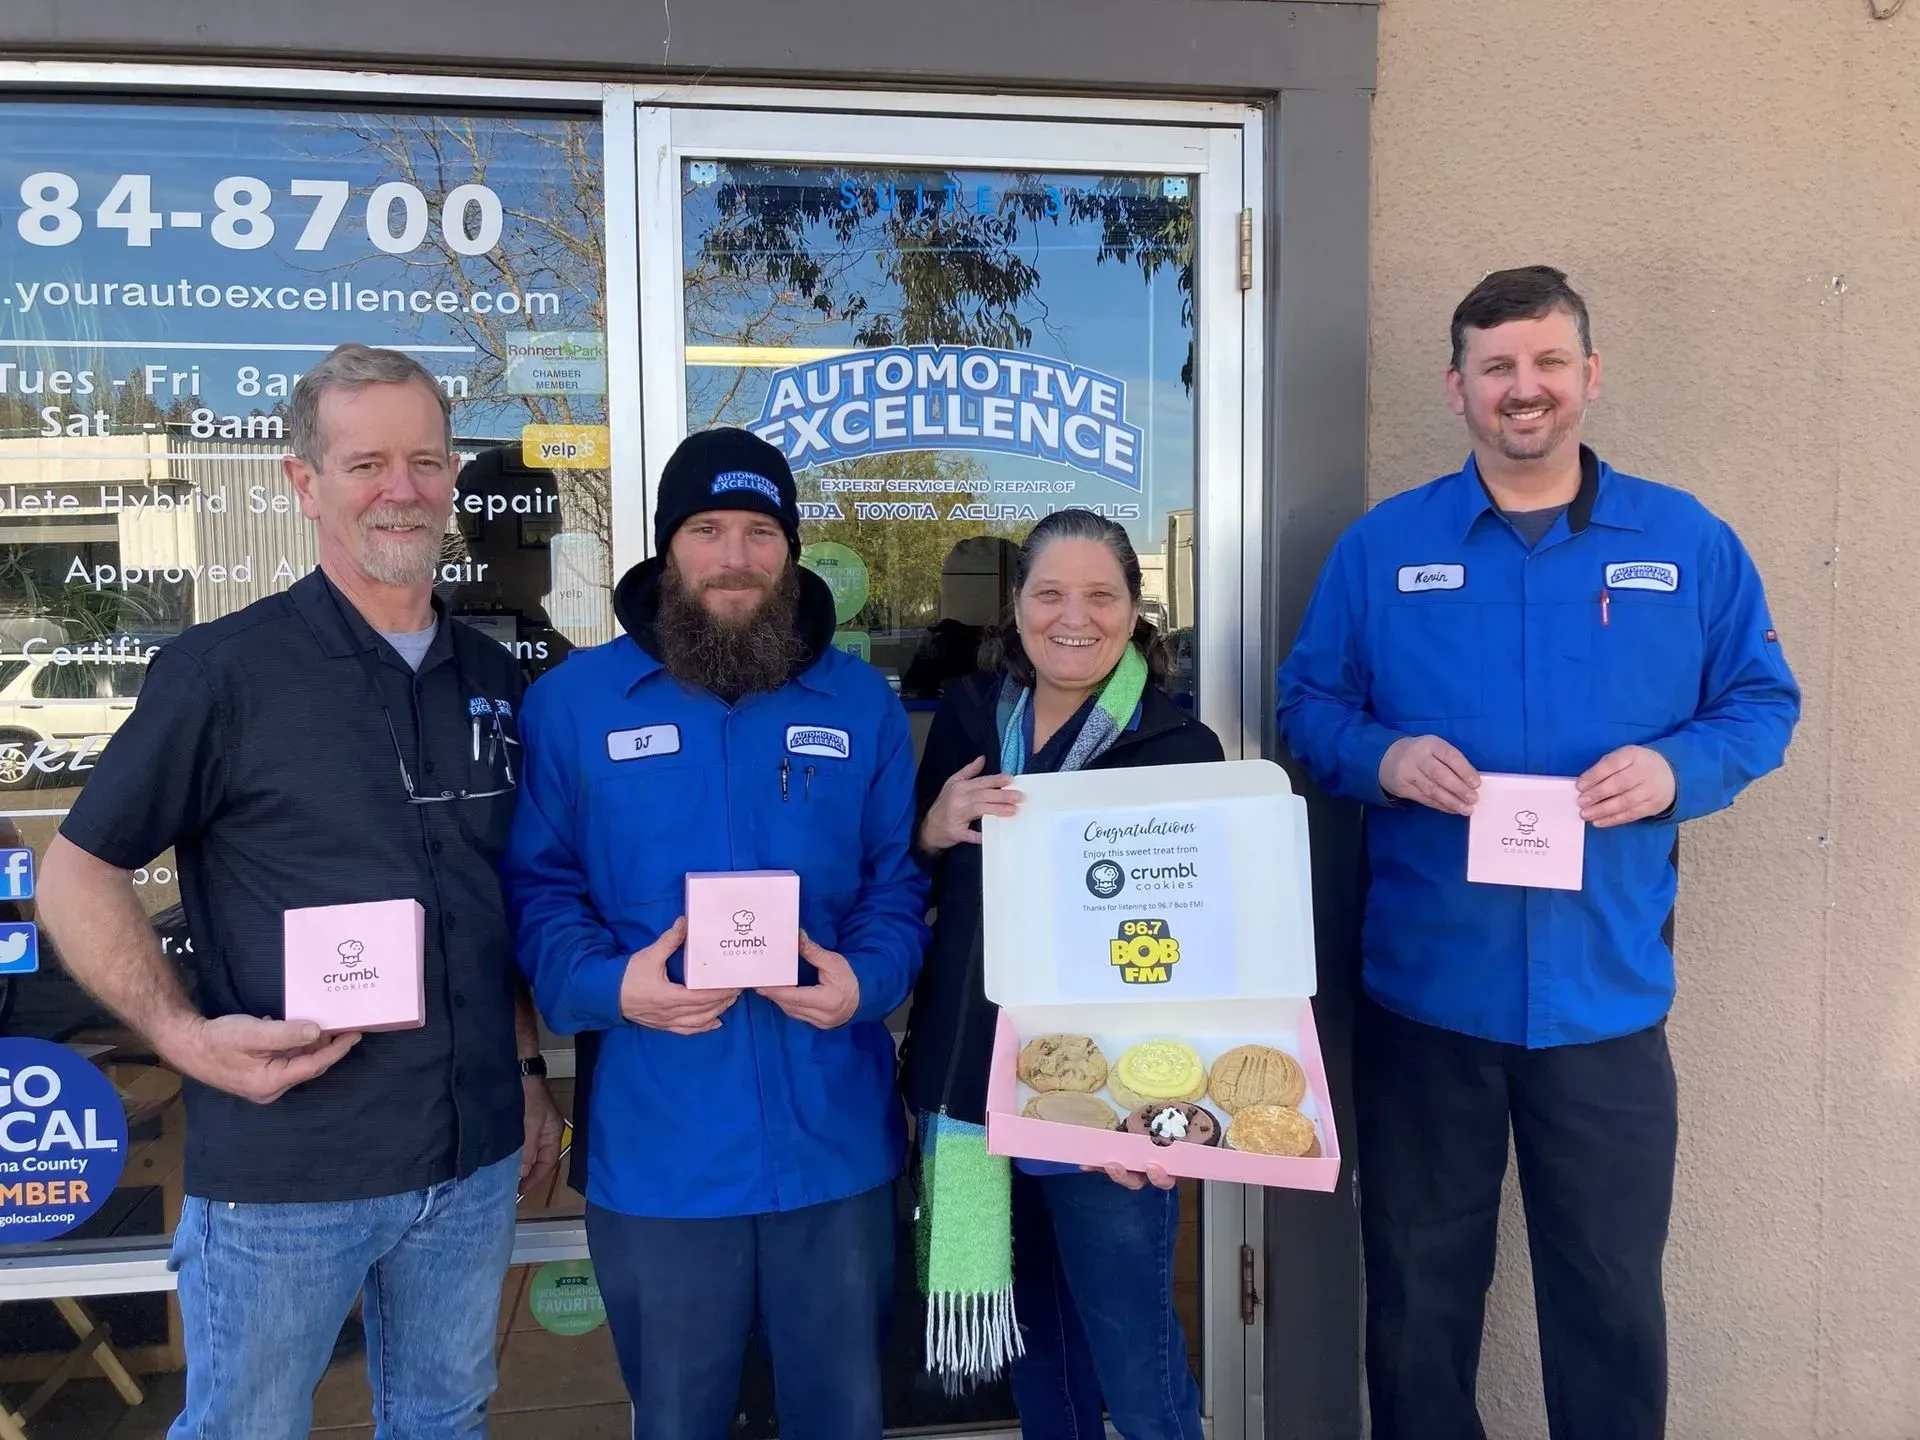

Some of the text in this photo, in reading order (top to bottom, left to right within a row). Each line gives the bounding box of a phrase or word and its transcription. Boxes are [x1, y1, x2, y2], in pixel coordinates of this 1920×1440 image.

[840, 180, 1061, 216] SUITE 3
[0, 171, 503, 256] 84-8700
[508, 344, 603, 357] Rohnert Park
[0, 362, 95, 395] Tues
[144, 364, 201, 396] Fri
[532, 369, 581, 379] CHAMBER
[535, 381, 579, 390] MEMBER
[769, 353, 1118, 421] AUTOMOTIVE
[41, 406, 110, 437] Sat
[190, 408, 284, 439] 8am
[755, 394, 1136, 474] EXCELLENCE
[541, 442, 577, 459] yelp
[716, 471, 779, 496] AUTOMOTIVE
[821, 479, 1075, 493] EXPERT SERVICE AND REPAIR OF
[713, 479, 781, 505] EXCELLENCE
[0, 485, 80, 513] lete
[100, 485, 227, 520] Hybrid
[856, 502, 938, 520] TOYOTA
[946, 503, 1038, 521] ACURA
[64, 556, 252, 591] Approved
[1415, 571, 1448, 584] Kevin
[1611, 571, 1674, 586] EXCELLENCE
[1613, 564, 1671, 578] AUTOMOTIVE
[559, 588, 583, 600] yelp
[634, 734, 653, 751] DJ
[791, 737, 846, 752] EXCELLENCE
[794, 731, 844, 744] AUTOMOTIVE
[1083, 817, 1197, 844] Congratulations
[1501, 837, 1550, 848] crumbl
[1083, 845, 1198, 859] Enjoy this sweet treat from
[1130, 862, 1198, 880] crumbl
[1135, 880, 1194, 891] cookies
[1083, 904, 1106, 912] Thanks
[1118, 903, 1147, 911] listening
[1157, 902, 1173, 910] 96.7
[1174, 901, 1188, 909] Bob
[1123, 920, 1162, 936] 96.7
[720, 935, 767, 948] crumbl
[722, 949, 764, 957] cookies
[1110, 936, 1180, 967] BOB
[323, 966, 379, 984] crumbl
[1124, 966, 1168, 983] FM
[327, 982, 376, 992] cookies
[22, 1157, 88, 1174] County
[562, 1277, 582, 1285] 2020
